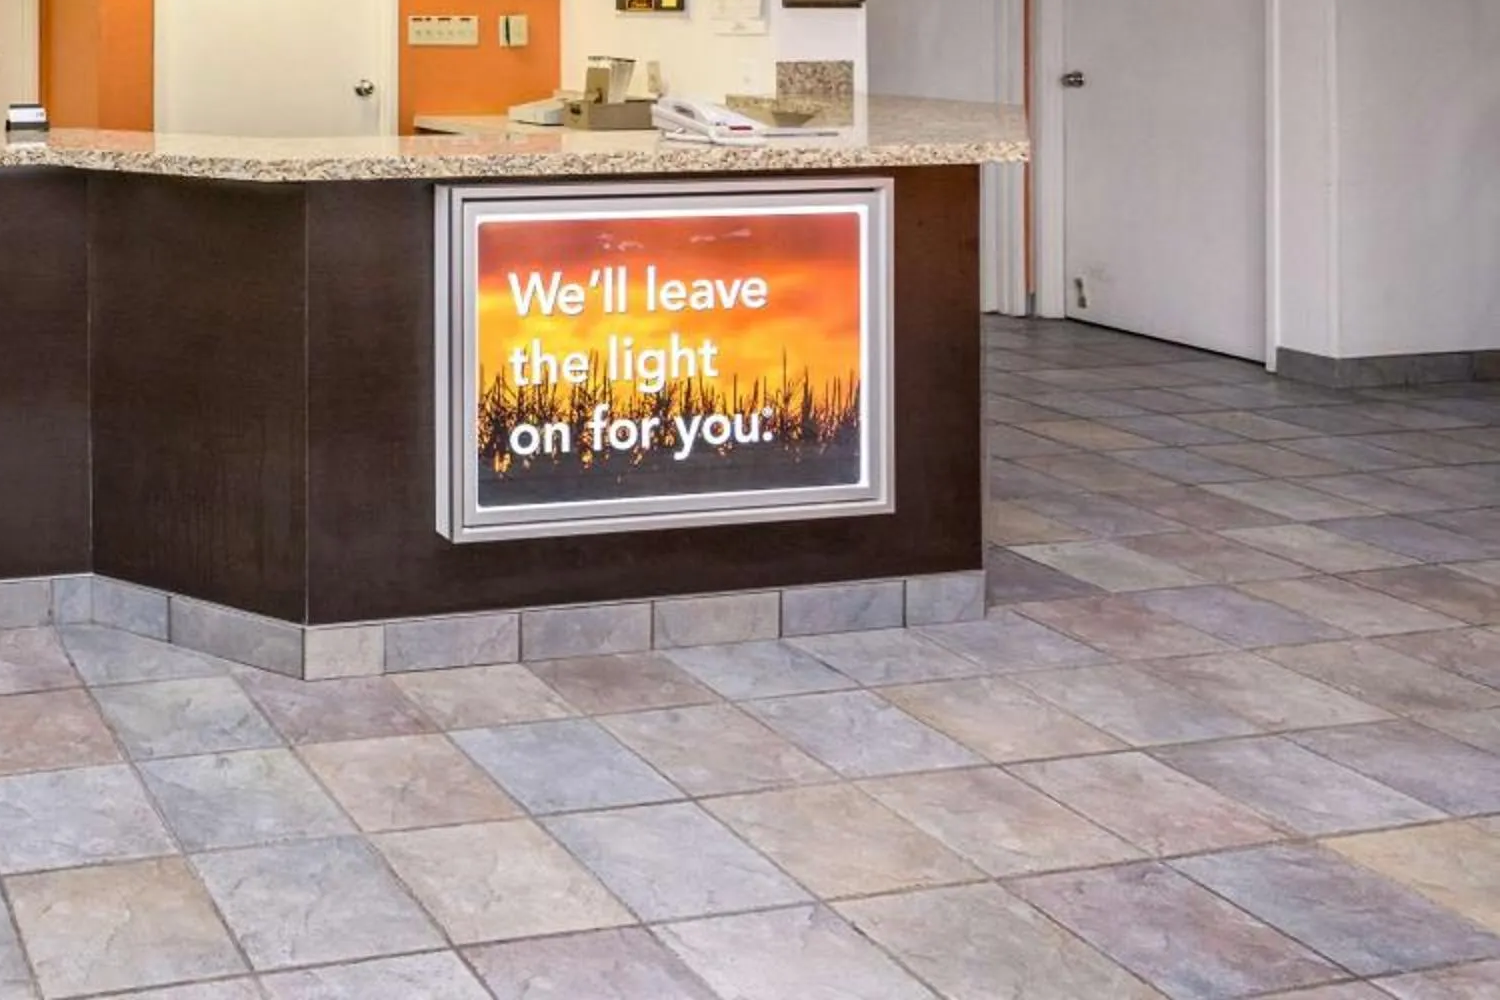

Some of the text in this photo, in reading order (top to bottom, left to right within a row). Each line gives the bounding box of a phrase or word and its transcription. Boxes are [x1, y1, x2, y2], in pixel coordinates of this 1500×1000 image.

[508, 265, 769, 316] We'll leave
[509, 332, 719, 393] the light
[509, 421, 571, 455] on
[591, 403, 660, 450] for
